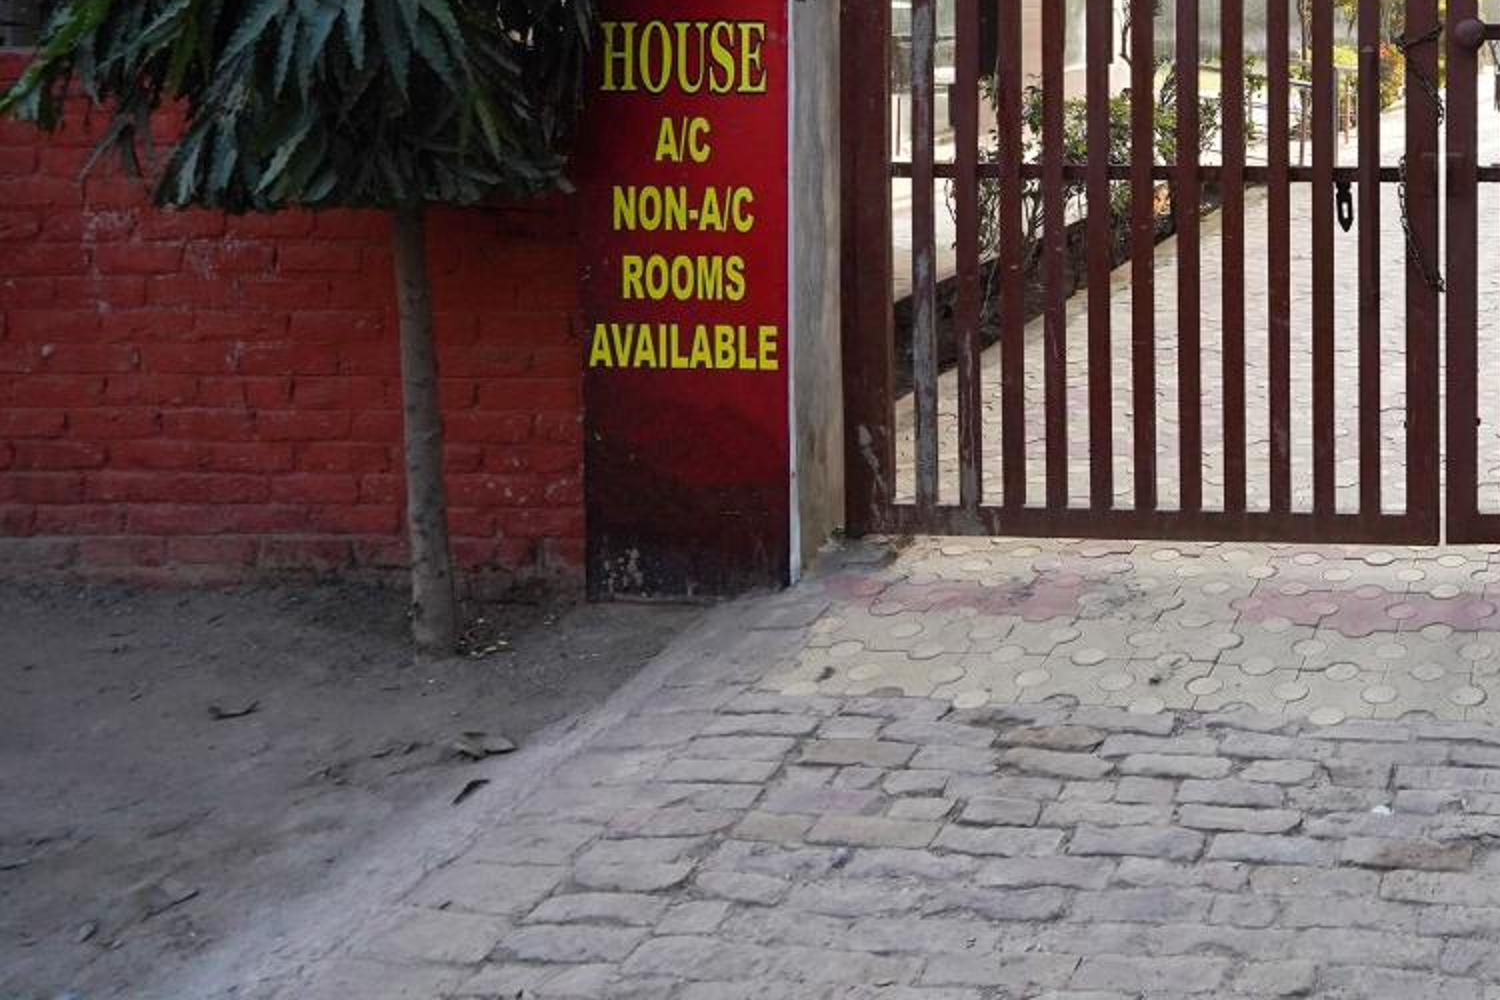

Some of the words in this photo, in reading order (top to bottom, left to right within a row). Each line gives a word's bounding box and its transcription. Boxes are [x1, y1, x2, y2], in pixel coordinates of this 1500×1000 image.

[600, 20, 768, 93] HOUSE
[655, 116, 711, 163] A/C
[612, 186, 754, 232] NON-A/C
[622, 253, 746, 301] ROOMS
[589, 323, 779, 370] AVAILABLE
